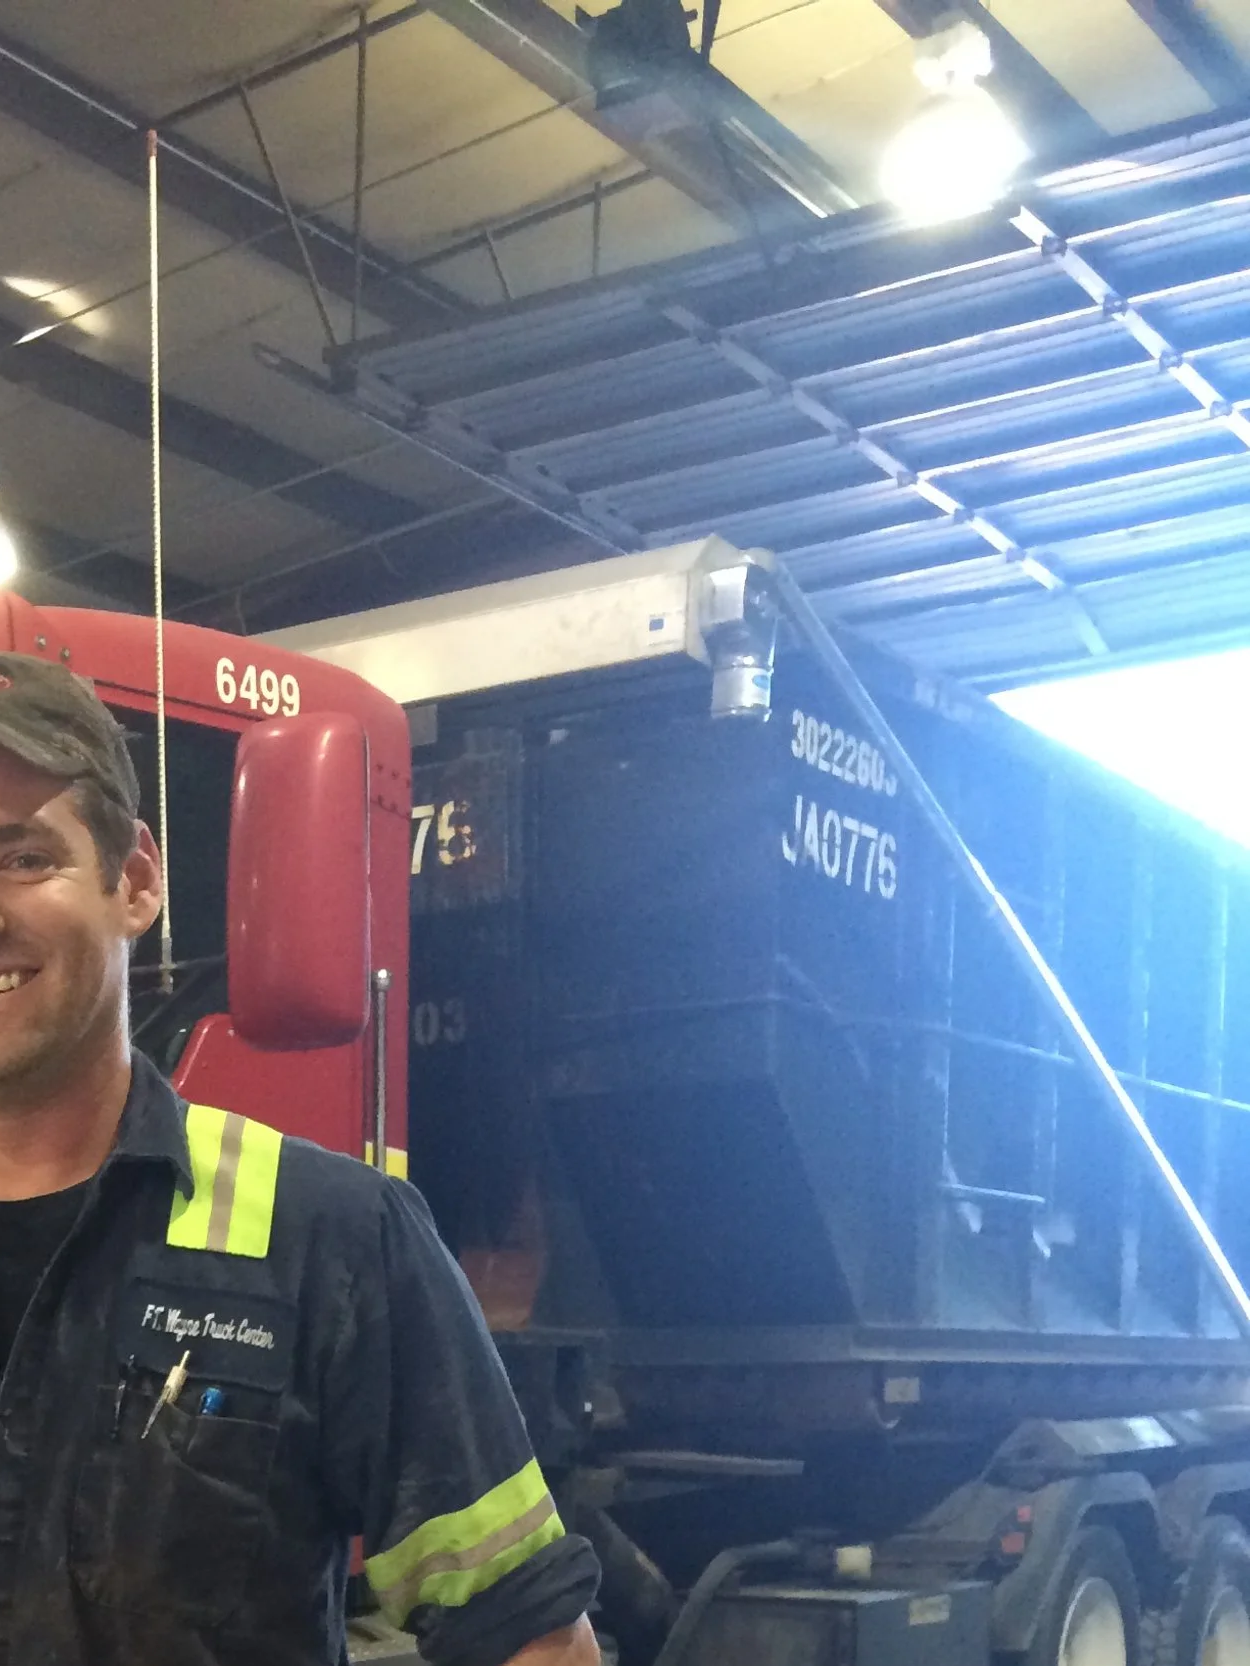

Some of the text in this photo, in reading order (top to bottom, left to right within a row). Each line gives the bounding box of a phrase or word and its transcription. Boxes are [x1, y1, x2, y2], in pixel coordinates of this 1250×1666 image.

[216, 657, 300, 717] 6499
[202, 1312, 236, 1341] Truck
[236, 1318, 275, 1350] Center
